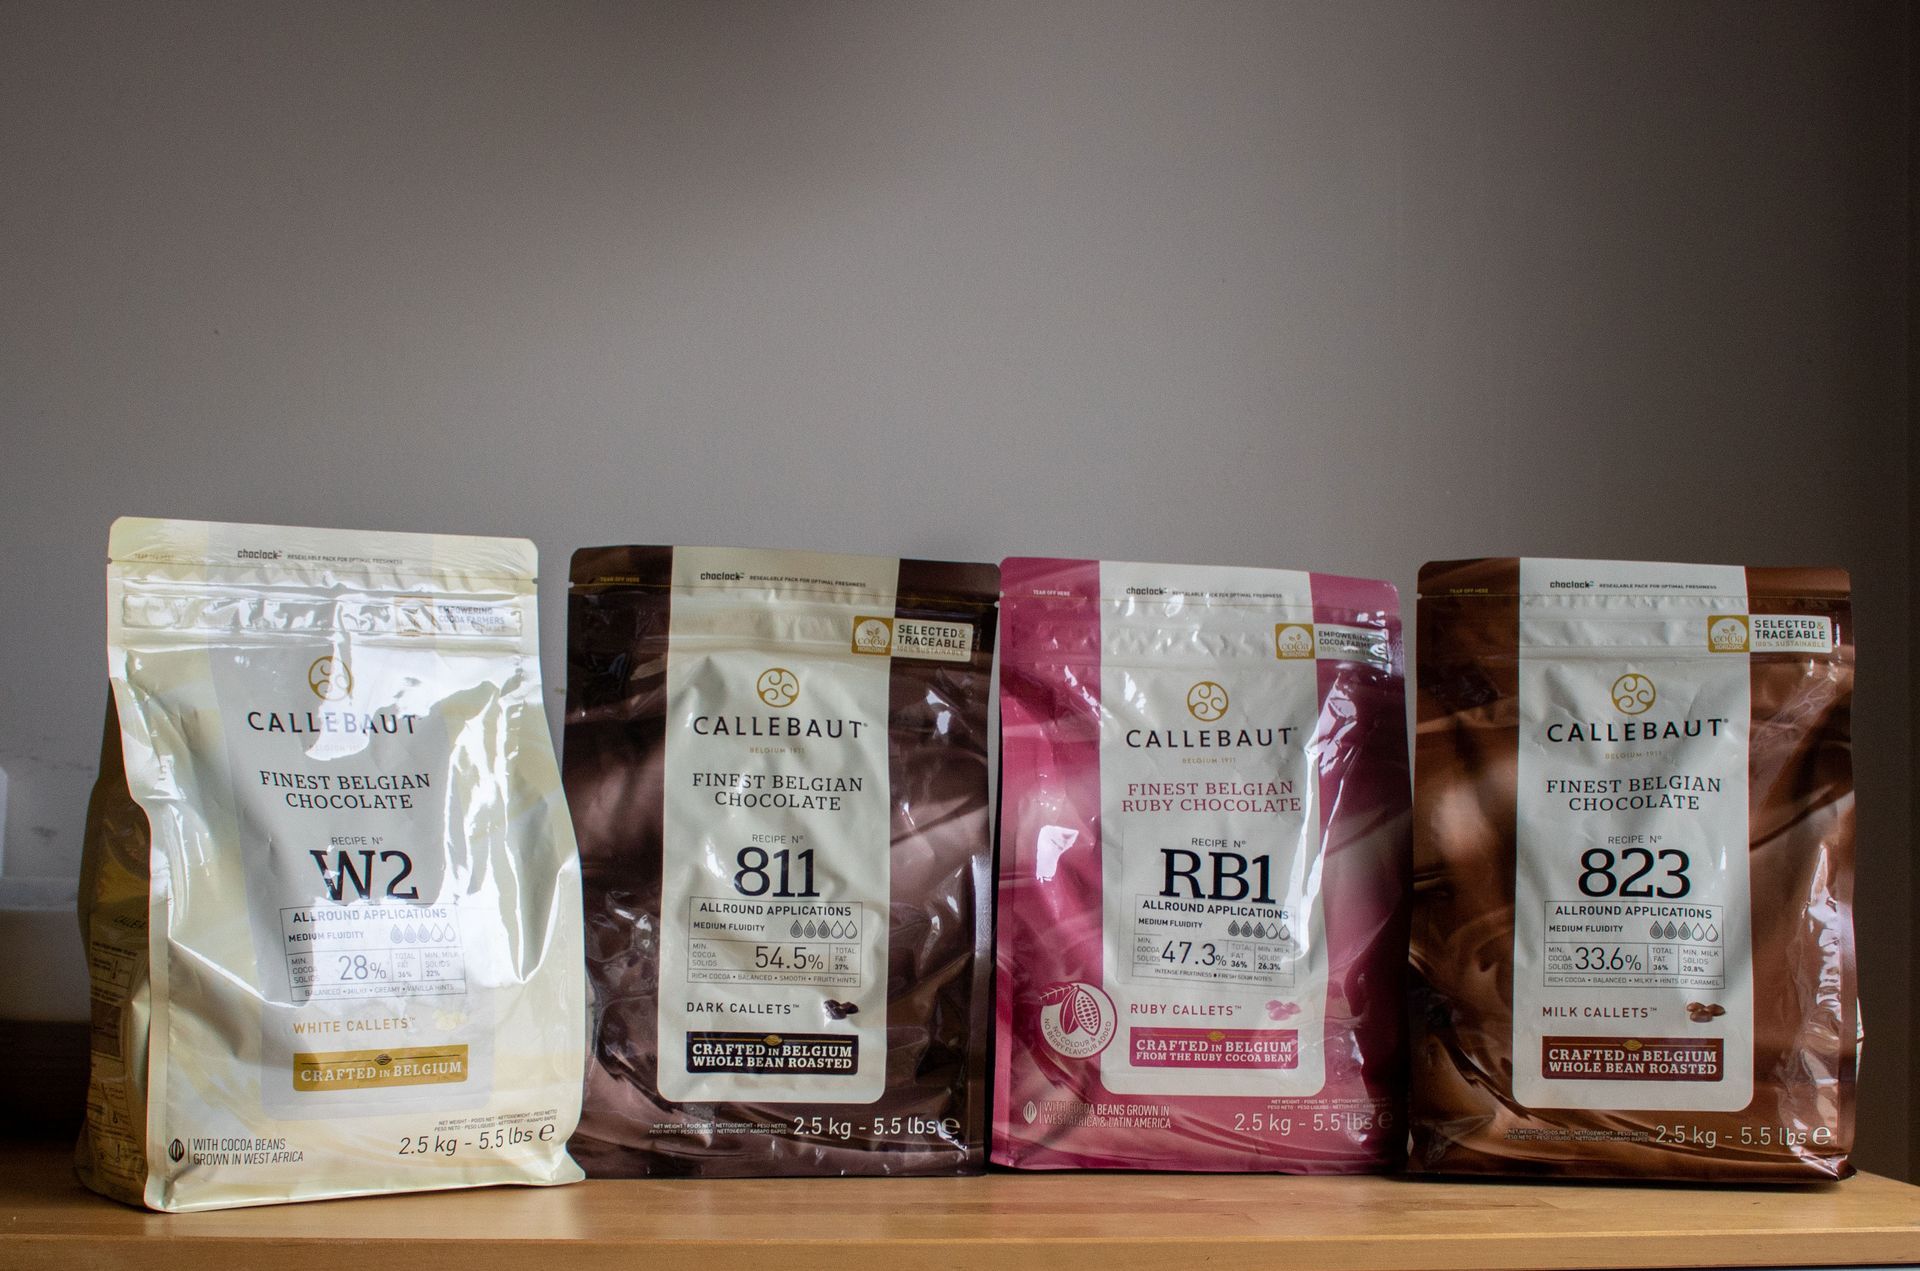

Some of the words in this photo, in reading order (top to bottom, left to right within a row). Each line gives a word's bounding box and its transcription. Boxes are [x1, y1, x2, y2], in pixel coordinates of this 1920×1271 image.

[1755, 629, 1825, 640] TRACEABLE
[898, 636, 966, 649] TRACEABLE
[248, 712, 416, 734] CALLEBAUT
[693, 716, 862, 738] CALLEBAUT
[1547, 718, 1722, 742] CALLEBAUT
[1126, 728, 1291, 748] CALLEBAUT
[260, 770, 330, 789] FINEST
[337, 774, 430, 790] BELGIAN
[693, 773, 765, 789] FINEST
[772, 775, 862, 792] BELGIAN
[1547, 780, 1621, 794] FINEST
[1629, 775, 1721, 792] BELGIAN
[1128, 783, 1199, 795] FINEST
[1206, 781, 1293, 795] BELGIAN
[286, 793, 413, 809] CHOCOLATE
[715, 791, 841, 810] CHOCOLATE
[1122, 799, 1173, 812] RUBY
[1181, 798, 1301, 813] CHOCOLATE
[1569, 795, 1699, 811] CHOCOLATE
[331, 837, 367, 845] RECIPE
[752, 835, 786, 843] RECIPE
[1192, 838, 1227, 847] RECIPE
[1608, 835, 1644, 844] RECIPE
[309, 850, 419, 900] W2
[734, 847, 819, 897] 811
[1160, 848, 1276, 904] RB1
[1578, 848, 1691, 898] 823
[293, 910, 360, 923] ALLROUND
[364, 908, 447, 920] APPLICATIONS
[700, 902, 763, 915] ALLROUND
[767, 905, 852, 916] APPLICATIONS
[1143, 900, 1204, 913] ALLROUND
[1207, 905, 1288, 919] APPLICATIONS
[1555, 906, 1621, 916] ALLROUND
[1625, 908, 1712, 919] APPLICATIONS
[693, 922, 726, 930] MEDIUM
[729, 923, 765, 932] FLUIDITY
[1170, 920, 1202, 928] FLUIDITY
[288, 932, 324, 942] MEDIUM
[327, 931, 364, 939] FLUIDITY
[755, 946, 823, 970] 54.5%
[1162, 940, 1227, 966] 47.3%
[1575, 947, 1642, 971] 33.6%
[338, 954, 386, 981] 28%
[1258, 962, 1281, 970] 26.3%
[687, 1002, 723, 1013] DARK
[1131, 1004, 1166, 1014] RUBY
[1542, 1007, 1578, 1017] MILK
[293, 1021, 339, 1034] WHITE
[1047, 1031, 1064, 1049] BERRY
[1065, 1045, 1097, 1055] FLAVOUR
[1136, 1040, 1208, 1051] CRAFTED
[1226, 1041, 1292, 1052] BELGIUM
[692, 1044, 766, 1055] CRAFTED
[768, 1048, 779, 1056] IN
[783, 1045, 852, 1058] BELGIUM
[1136, 1052, 1166, 1060] FROM
[1170, 1053, 1191, 1061] THE
[1194, 1053, 1222, 1061] RUBY
[1225, 1053, 1261, 1062] COCOA
[1264, 1054, 1292, 1062] BEAN
[1549, 1049, 1625, 1061] CRAFTED
[1643, 1050, 1716, 1062] BELGIUM
[693, 1056, 743, 1066] WHOLE
[747, 1057, 784, 1067] BEAN
[788, 1058, 852, 1068] ROASTED
[1549, 1062, 1601, 1072] WHOLE
[1605, 1063, 1645, 1073] BEAN
[1649, 1064, 1717, 1074] ROASTED
[301, 1067, 376, 1081] CRAFTED
[393, 1062, 461, 1077] BELGIUM
[1097, 1104, 1125, 1116] BEANS
[1127, 1105, 1158, 1116] GROWN
[1161, 1105, 1169, 1116] IN
[793, 1117, 822, 1135] 2.5
[829, 1117, 851, 1140] kg
[874, 1117, 901, 1135] 5.5
[908, 1117, 936, 1134] lbs
[1108, 1116, 1132, 1128] LATIN
[1134, 1118, 1171, 1128] AMERICA
[1234, 1113, 1262, 1131] 2.5
[1269, 1113, 1291, 1136] kg
[1313, 1113, 1340, 1131] 5.5
[1346, 1113, 1372, 1129] lbs
[193, 1138, 218, 1150] WITH
[222, 1139, 252, 1151] COCOA
[255, 1138, 285, 1150] BEANS
[399, 1136, 428, 1155] 2.5
[435, 1135, 457, 1156] kg
[479, 1129, 503, 1150] 5.5
[508, 1127, 533, 1144] lbs
[1655, 1125, 1686, 1143] 2.5
[1693, 1126, 1717, 1149] kg
[1741, 1127, 1771, 1145] 5.5
[1779, 1127, 1806, 1146] lbs
[194, 1153, 228, 1166] GROWN
[232, 1154, 241, 1164] IN
[243, 1153, 270, 1164] WEST
[272, 1151, 303, 1163] AFRICA
